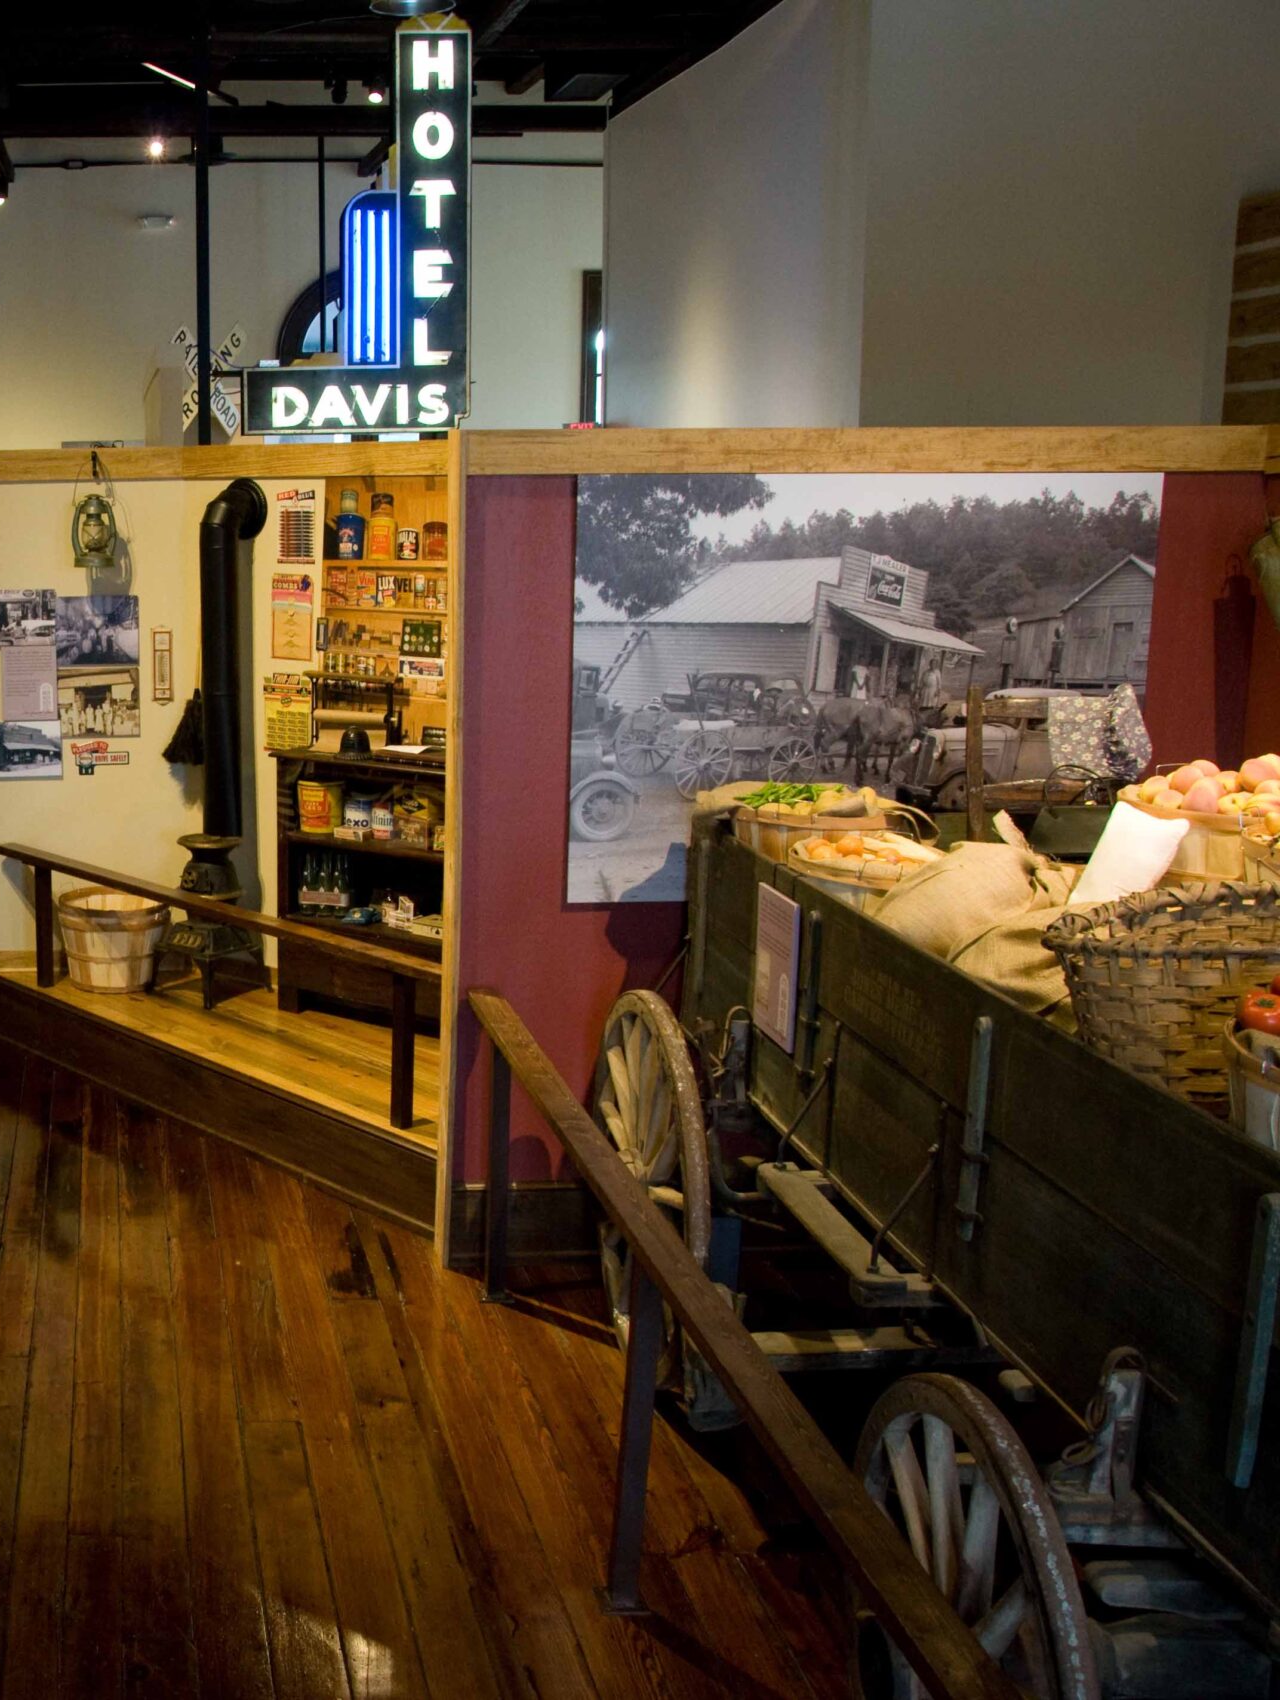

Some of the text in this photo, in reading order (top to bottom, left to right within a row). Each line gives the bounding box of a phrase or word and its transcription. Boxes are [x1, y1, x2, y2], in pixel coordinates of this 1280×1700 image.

[408, 39, 456, 366] HOTEL
[271, 383, 450, 428] DAVIS
[378, 576, 395, 590] LUX
[396, 577, 414, 593] VEL
[346, 817, 369, 828] exo
